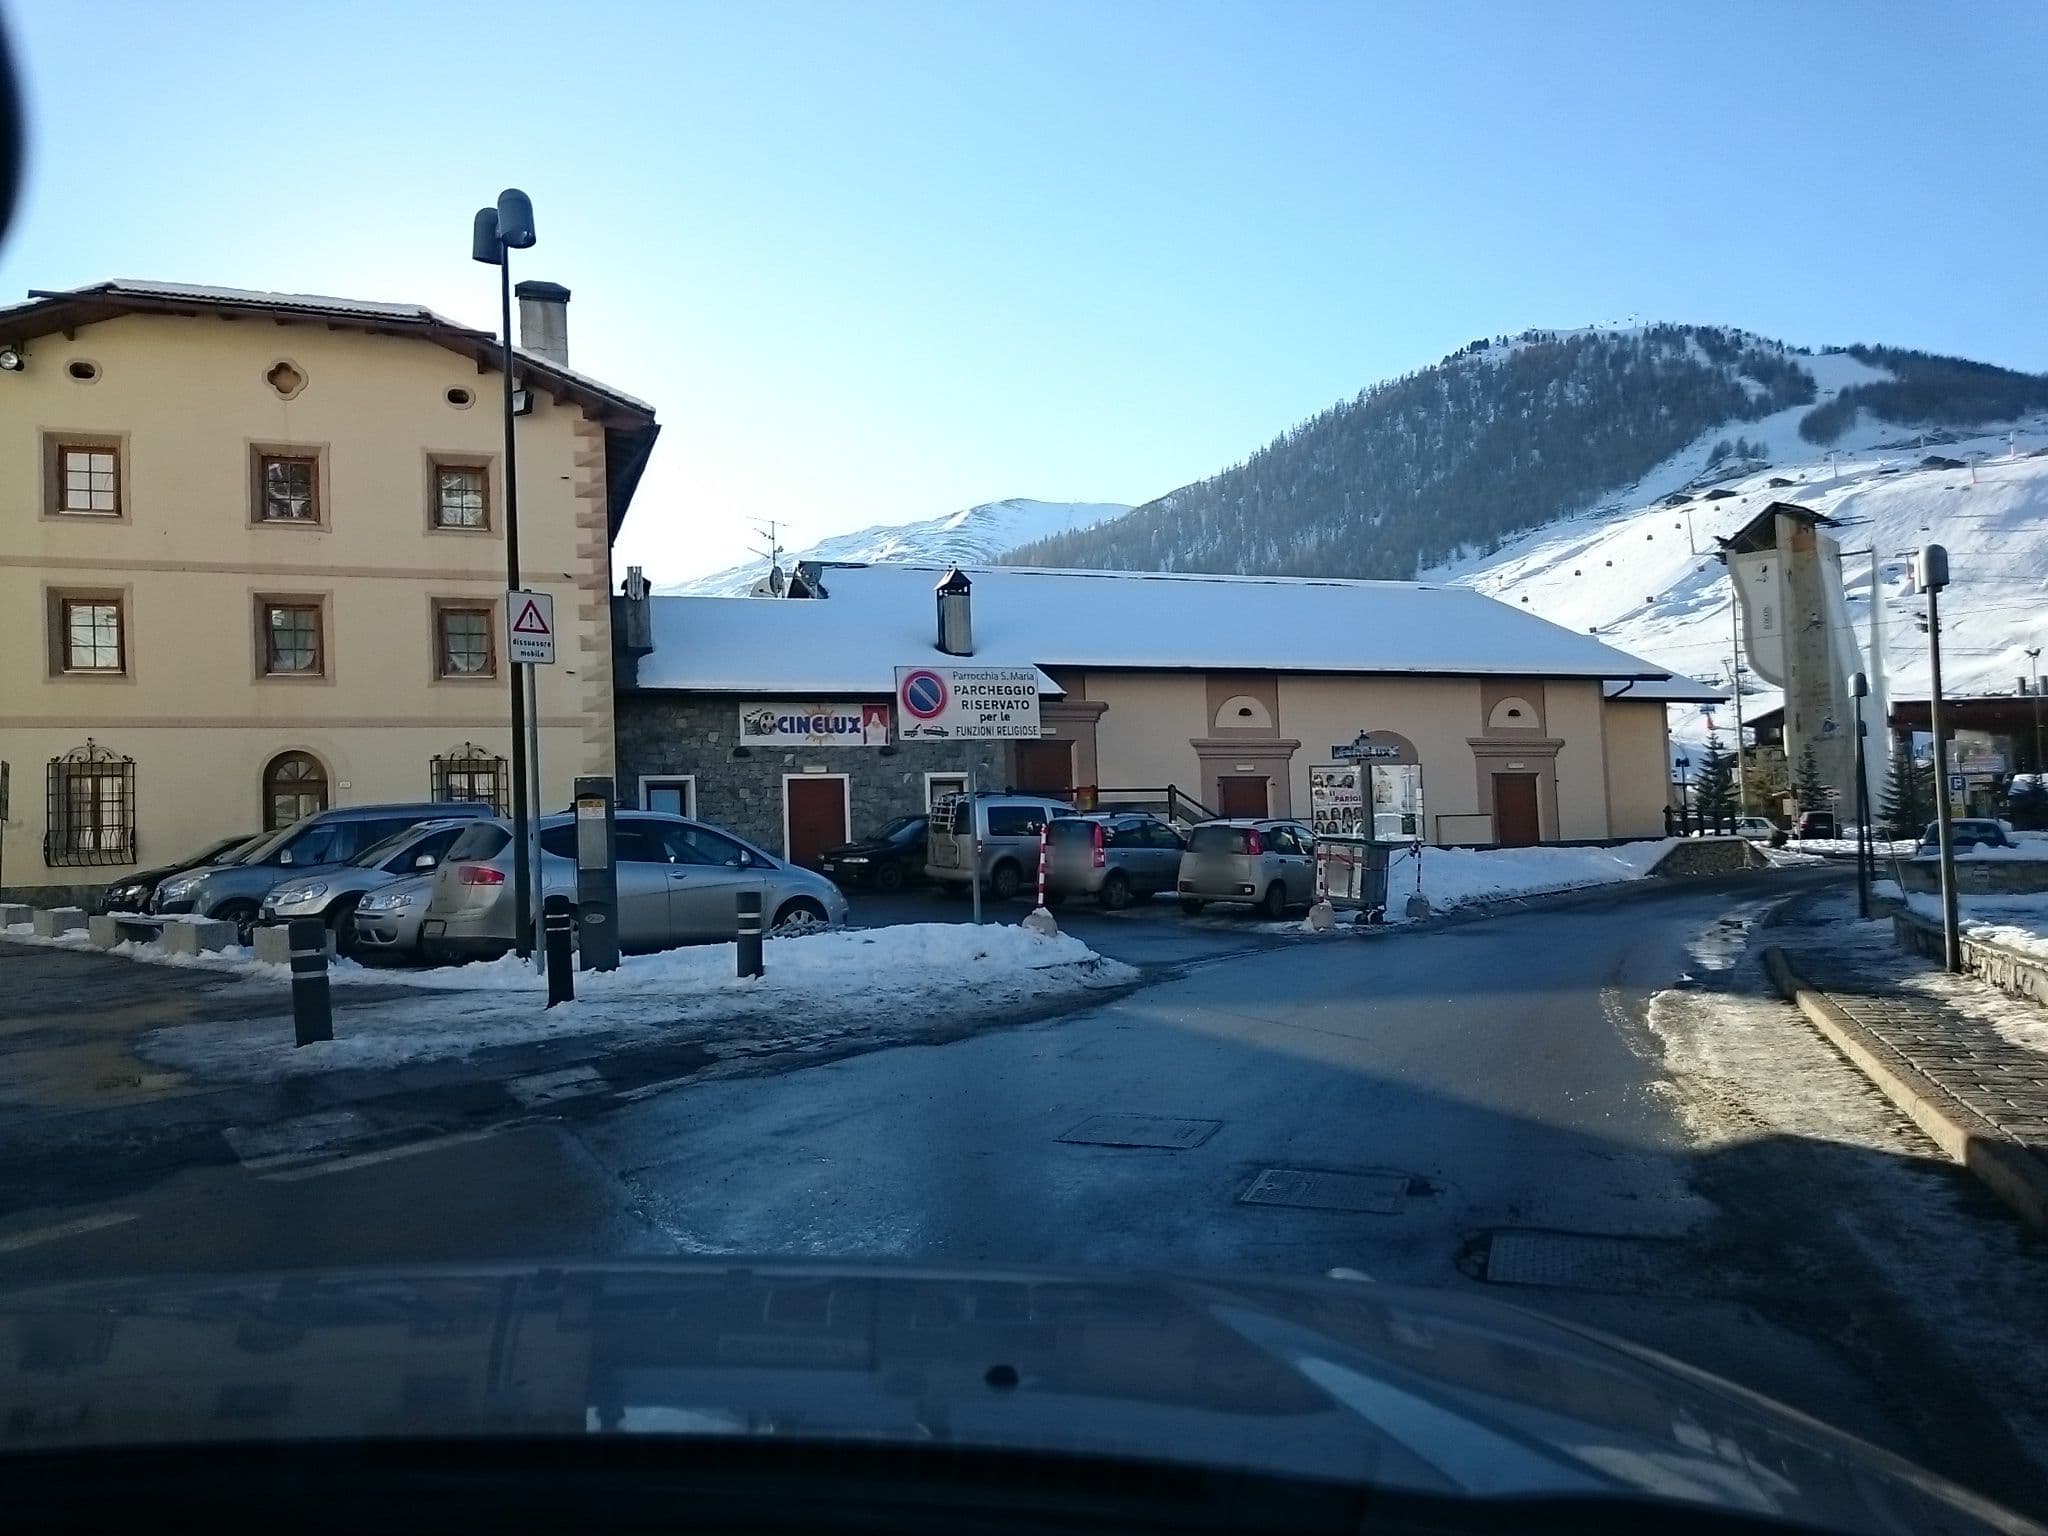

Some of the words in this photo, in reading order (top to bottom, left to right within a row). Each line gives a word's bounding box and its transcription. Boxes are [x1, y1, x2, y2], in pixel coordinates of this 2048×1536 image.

[521, 650, 545, 658] mobile
[953, 671, 999, 681] Parrocchia
[1001, 672, 1009, 681] S.
[1010, 672, 1035, 681] Maria
[953, 685, 1036, 696] PARCHEGGIO
[961, 700, 1030, 710] RISERVATO
[980, 713, 997, 723] per
[1001, 712, 1011, 721] le
[777, 715, 862, 735] CINELUX
[956, 726, 995, 737] FUNZIONI
[997, 725, 1038, 736] RELIGIOSE
